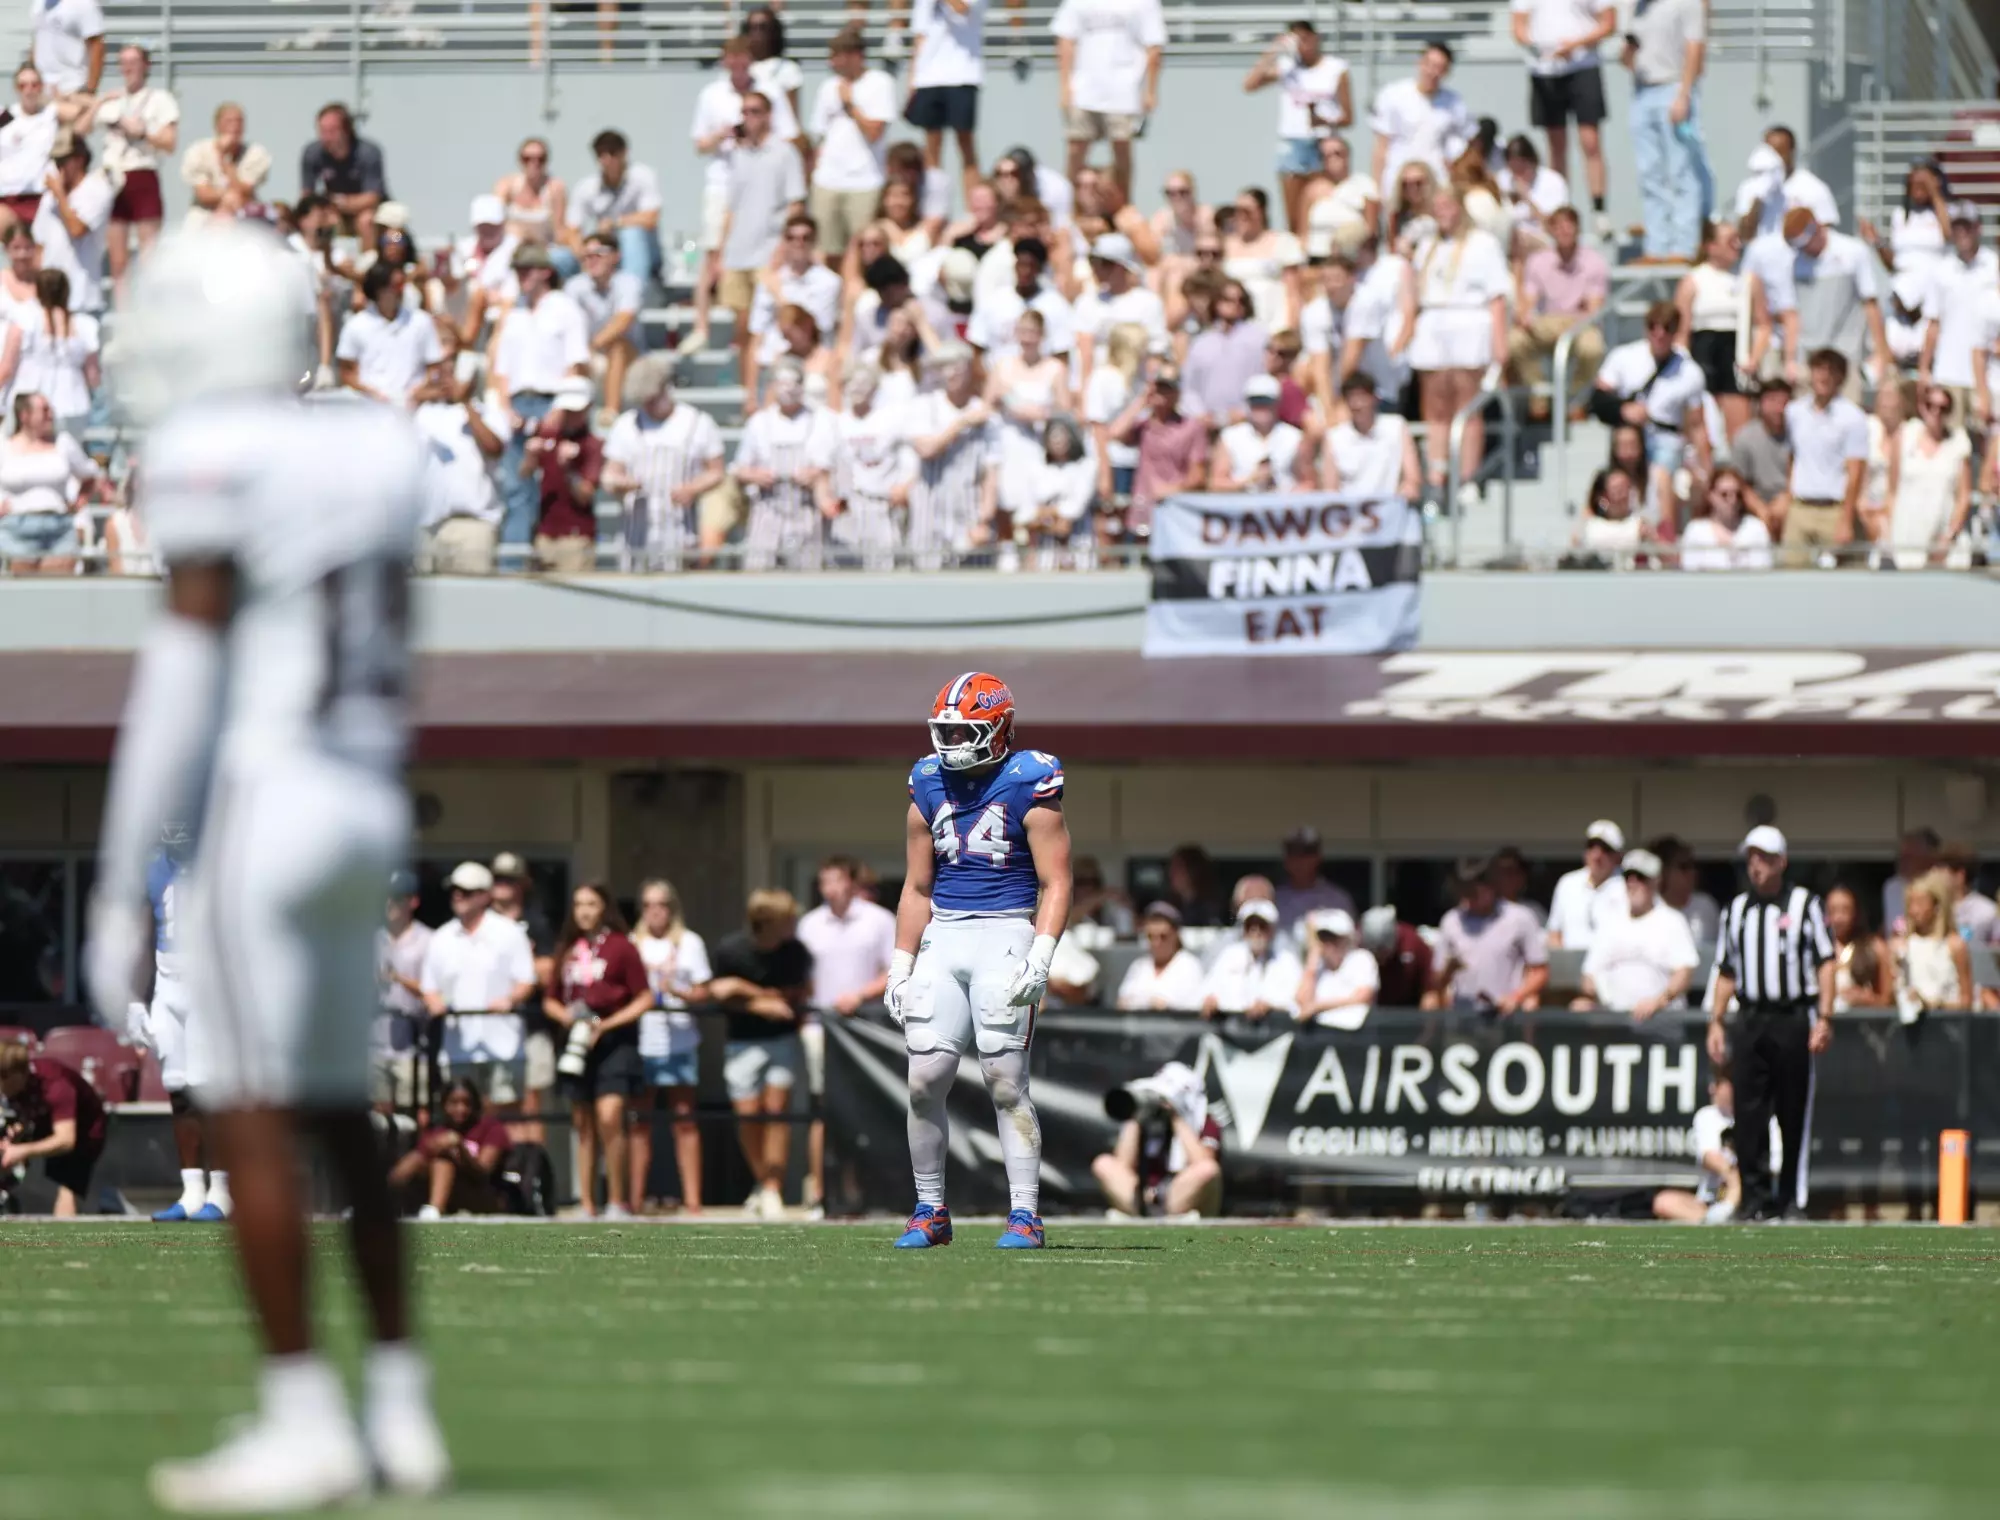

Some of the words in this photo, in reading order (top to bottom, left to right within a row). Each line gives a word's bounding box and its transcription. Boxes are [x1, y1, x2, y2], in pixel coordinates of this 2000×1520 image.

[1201, 501, 1380, 545] DAWGS
[1207, 549, 1373, 599] FINNA
[1244, 606, 1327, 644] EAT
[931, 801, 1012, 867] 44
[1294, 1041, 1698, 1116] AIRSOUTH
[1287, 1126, 1407, 1157] COOLING
[1428, 1126, 1545, 1157] HEATING
